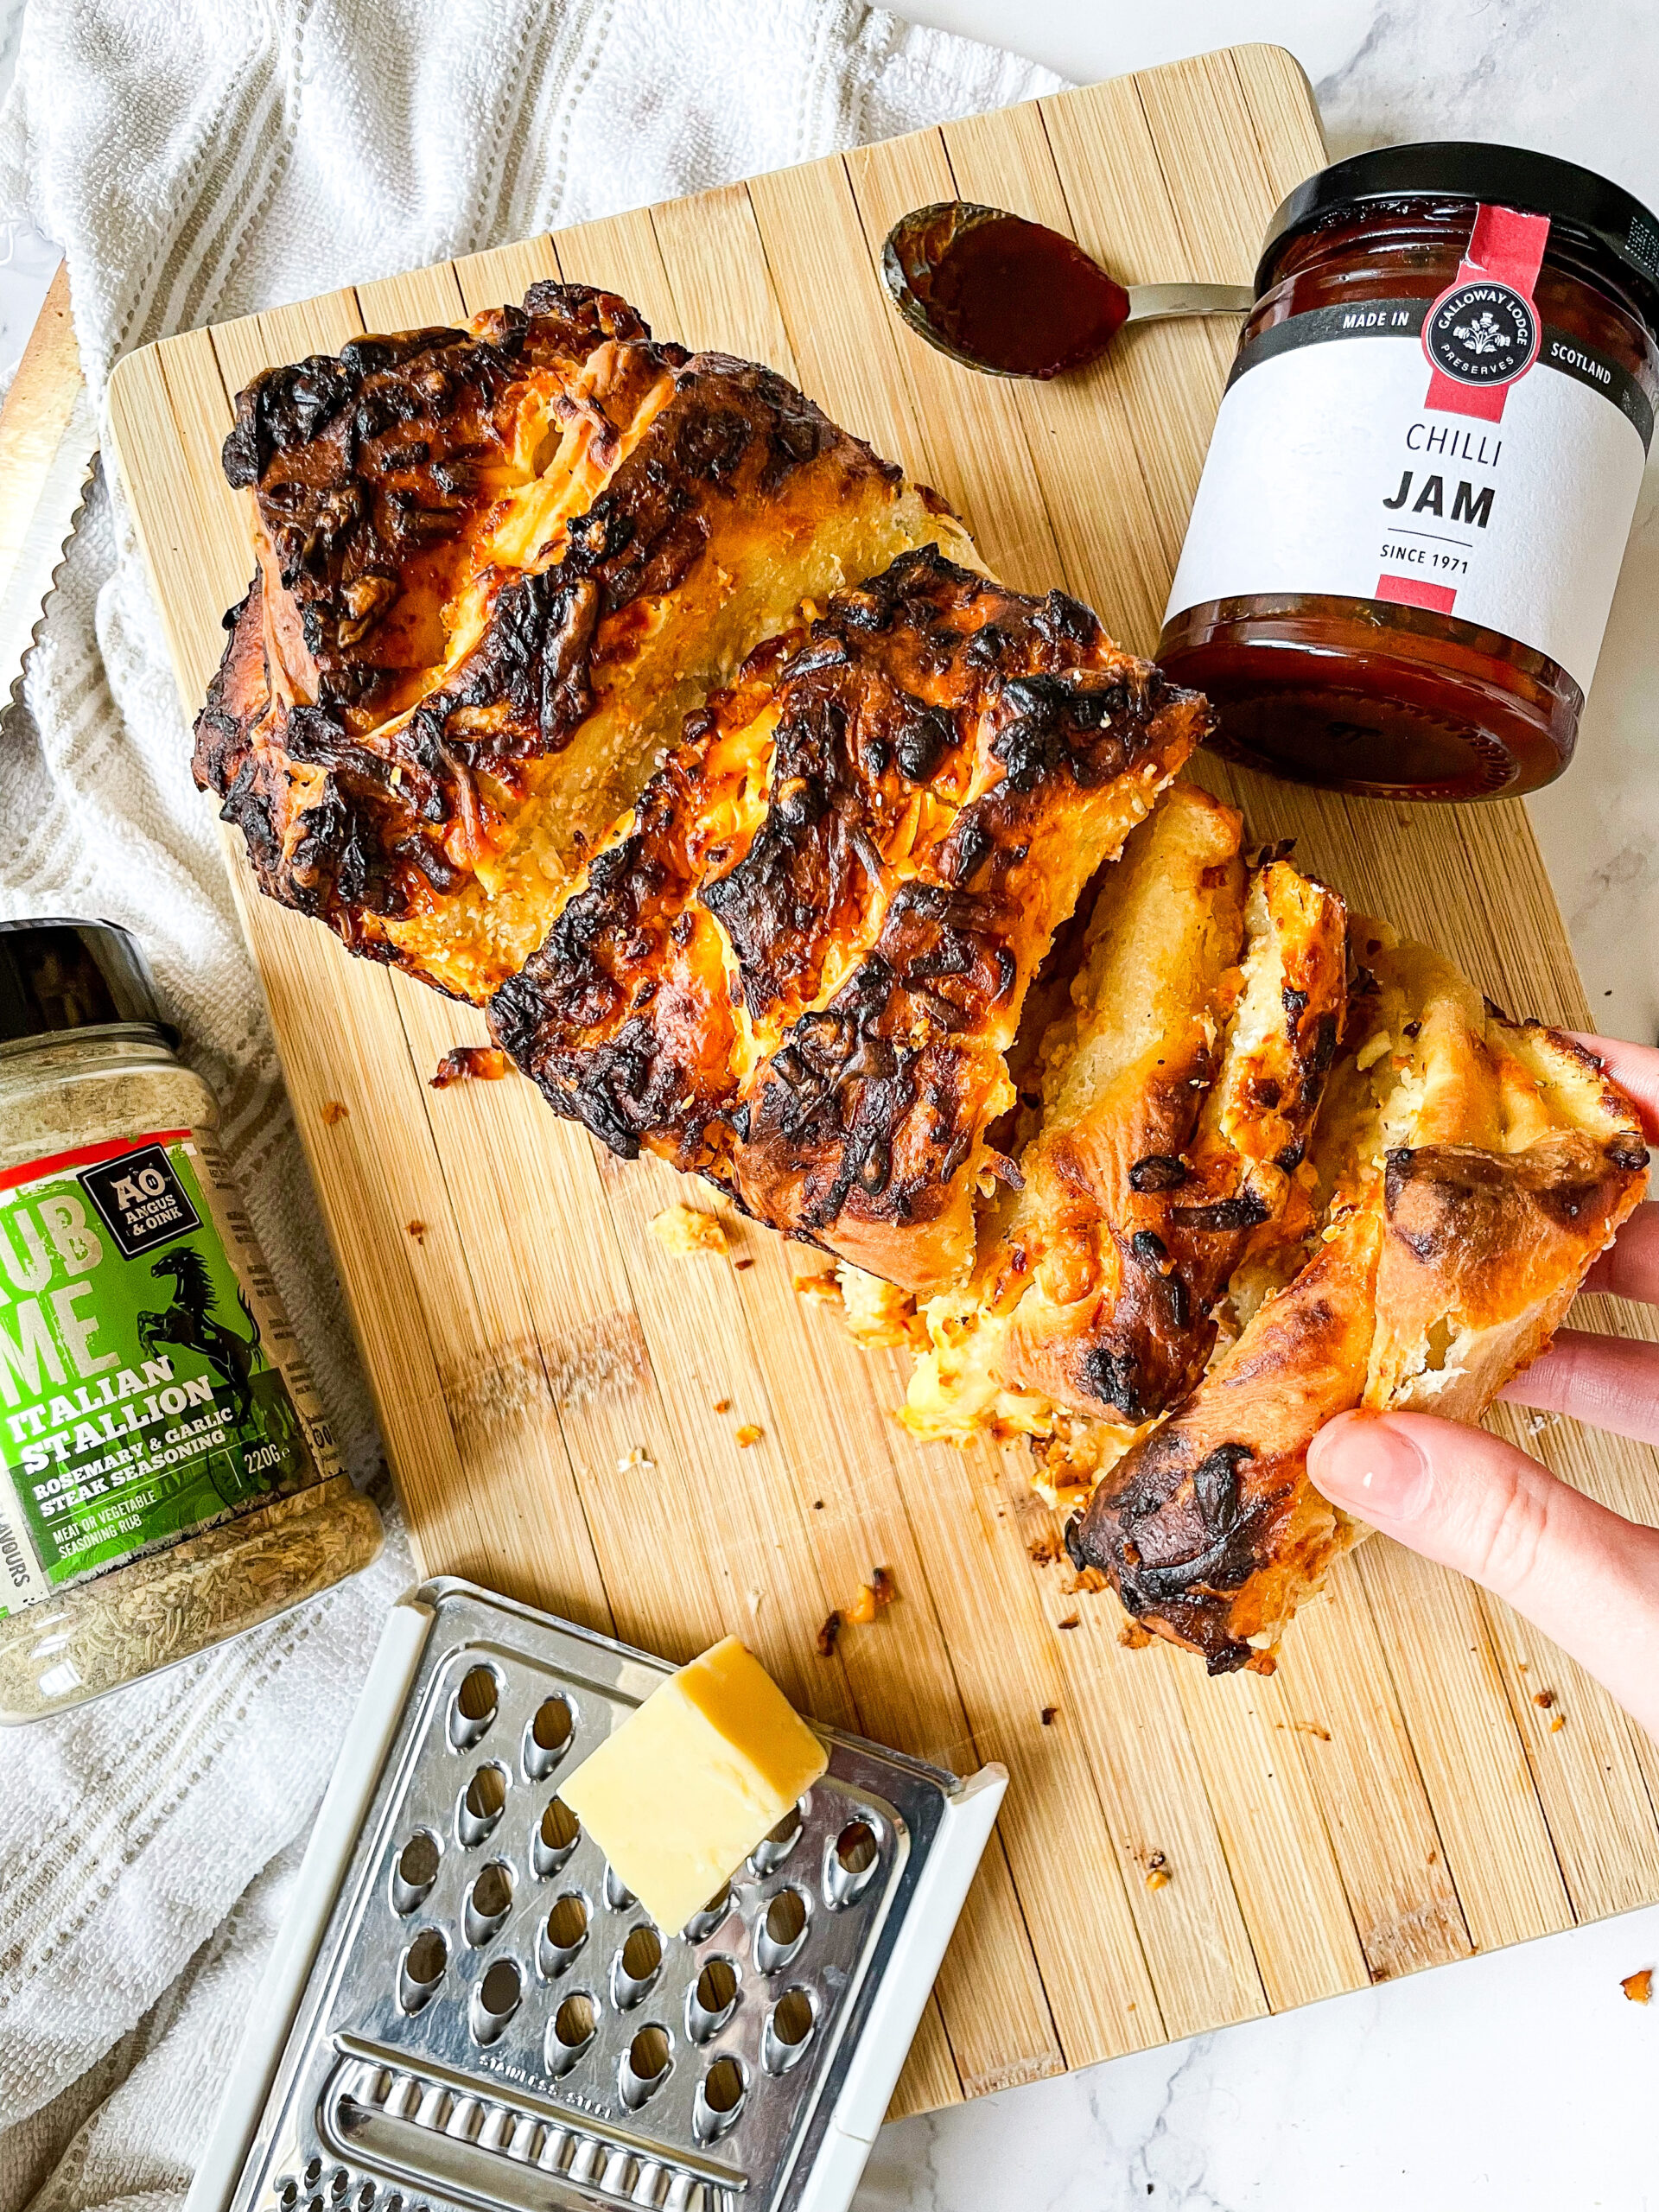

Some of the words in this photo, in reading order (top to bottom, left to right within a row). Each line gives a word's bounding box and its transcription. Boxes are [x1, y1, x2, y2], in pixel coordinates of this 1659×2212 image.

[1438, 289, 1508, 330] GALLOWAY
[1506, 301, 1528, 346] LODGE
[1342, 312, 1387, 329] MADE
[1390, 311, 1410, 327] IN
[1550, 342, 1611, 385] SCOTLAND
[1440, 343, 1515, 375] PRESERVES
[1406, 423, 1503, 467] CHILLI
[1382, 470, 1496, 529] JAM
[1380, 544, 1426, 564] SINCE
[1432, 554, 1468, 575] 1971
[125, 1194, 176, 1224] ANGUS
[132, 1224, 147, 1236] &
[145, 1206, 183, 1230] OINK
[0, 1194, 104, 1307] UB
[0, 1280, 122, 1408] ME
[6, 1354, 175, 1445] ITALIAN
[21, 1375, 215, 1476] STALLION
[32, 1441, 144, 1502] ROSEMARY
[149, 1438, 163, 1452] &
[164, 1407, 234, 1444] GARLIC
[39, 1478, 111, 1519] STEAK
[111, 1429, 226, 1489] SEASONING
[244, 1442, 282, 1475] 220G
[52, 1520, 81, 1546] MEAT
[81, 1514, 98, 1532] OR
[99, 1490, 158, 1525] VEGETABLE
[58, 1525, 118, 1560] SEASONING
[119, 1514, 143, 1533] RUB
[0, 1513, 30, 1588] AVOURS
